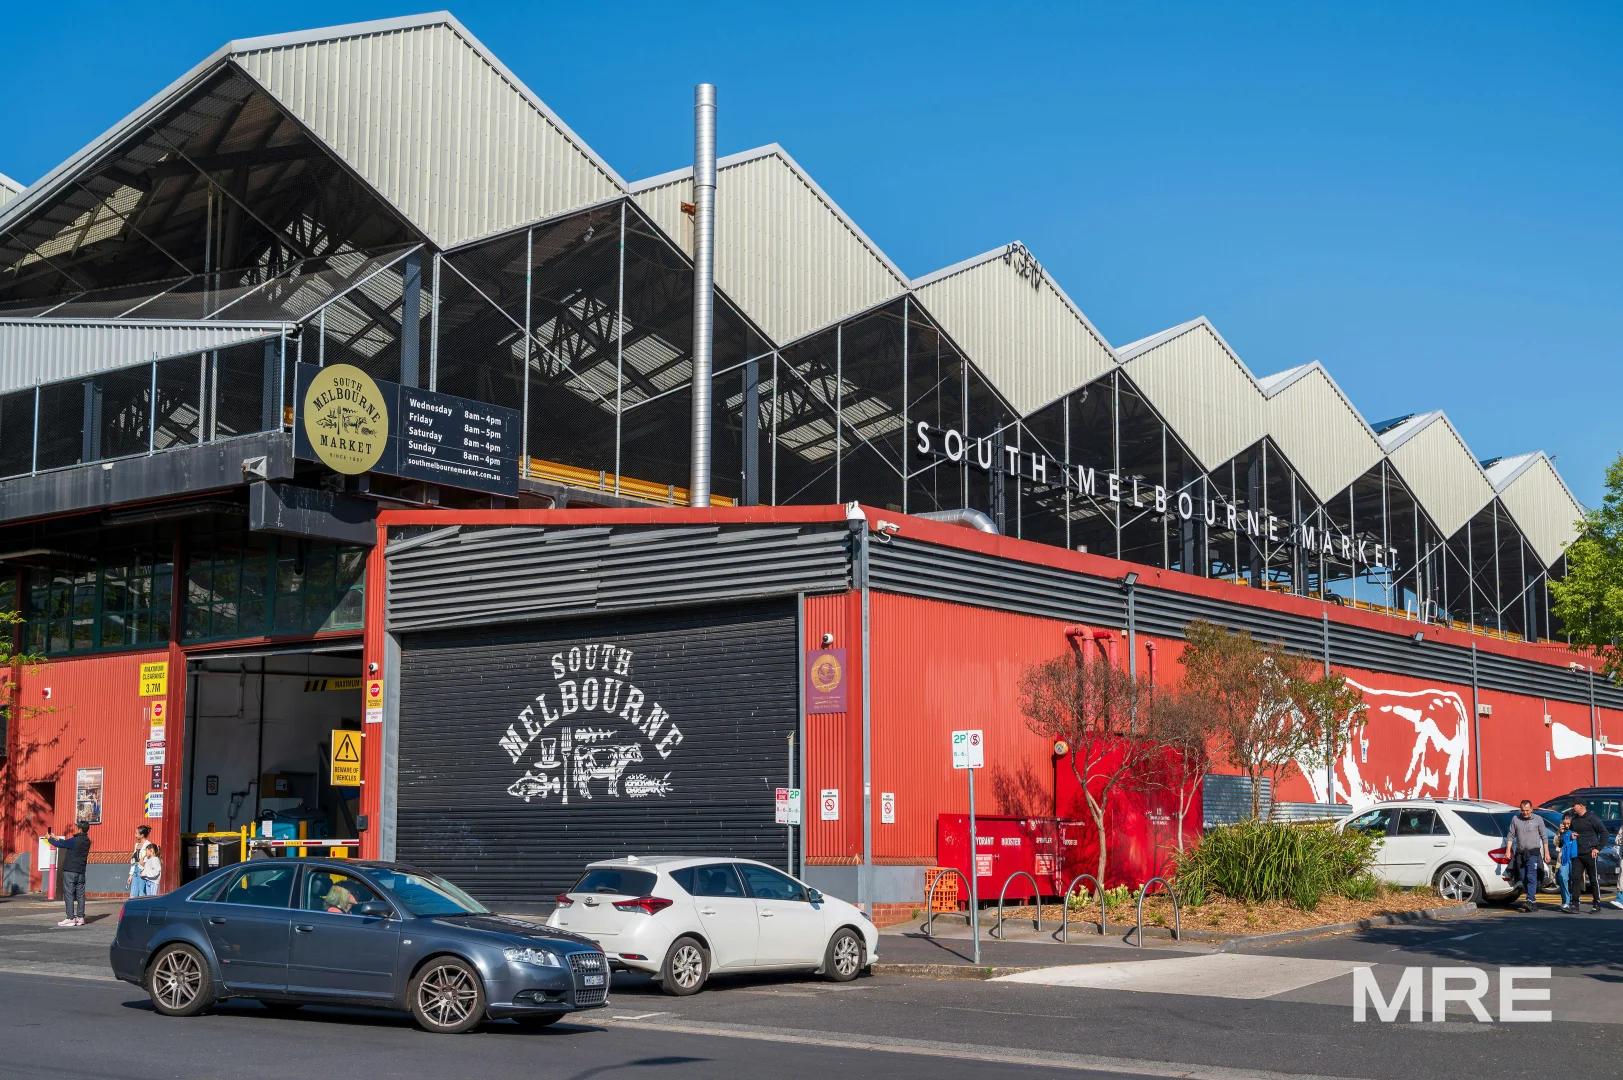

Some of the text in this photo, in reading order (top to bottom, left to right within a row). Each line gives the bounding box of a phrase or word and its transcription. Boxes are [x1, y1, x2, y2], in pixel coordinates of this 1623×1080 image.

[333, 377, 363, 392] SOUTH
[312, 387, 381, 423] MELBOURNE
[409, 398, 453, 416] Wednesday
[409, 412, 433, 426] Friday
[464, 410, 480, 421] 8am
[486, 415, 502, 426] 4pm
[408, 426, 443, 442] Saturday
[464, 424, 480, 434] 8am
[486, 428, 501, 439] 5pm
[320, 434, 372, 454] MARKET
[408, 440, 436, 455] Sunday
[463, 437, 480, 448] 8am
[485, 442, 501, 452] 4pm
[329, 452, 347, 460] SINCE
[463, 451, 479, 461] 8am
[485, 455, 501, 466] 4pm
[408, 458, 501, 481] southmelbournemarket.com.au
[917, 421, 1398, 571] SOUTH MELBOURNE MARKET
[551, 644, 633, 679] SOUTH
[145, 683, 161, 693] 3.7M
[335, 680, 360, 688] MAXIMUM
[499, 677, 683, 764] MELBOURNE
[954, 734, 966, 744] 2P
[790, 790, 800, 799] 2P
[975, 837, 994, 846] YDRANT
